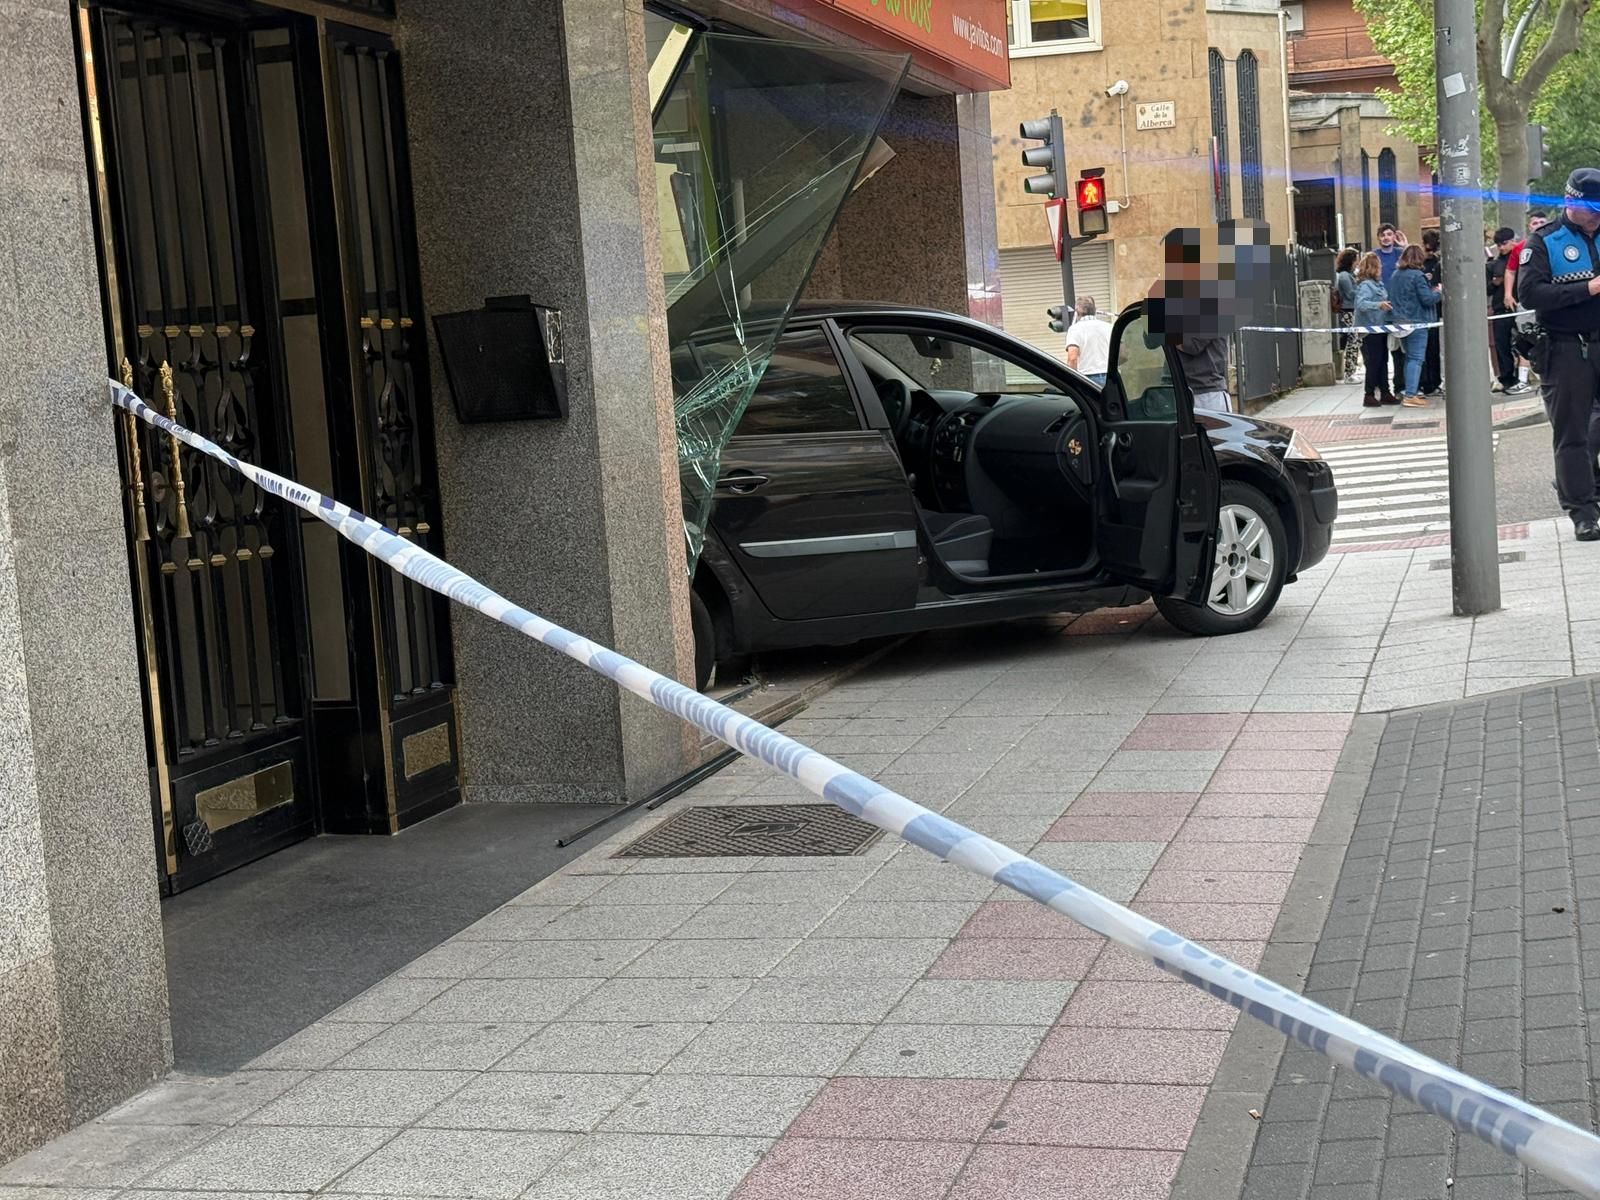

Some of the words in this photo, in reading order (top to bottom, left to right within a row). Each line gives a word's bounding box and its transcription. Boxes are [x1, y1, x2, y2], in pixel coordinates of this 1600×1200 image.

[952, 14, 1003, 58] www.javitos.com
[1151, 104, 1170, 112] Calle
[1140, 119, 1172, 128] Alberca
